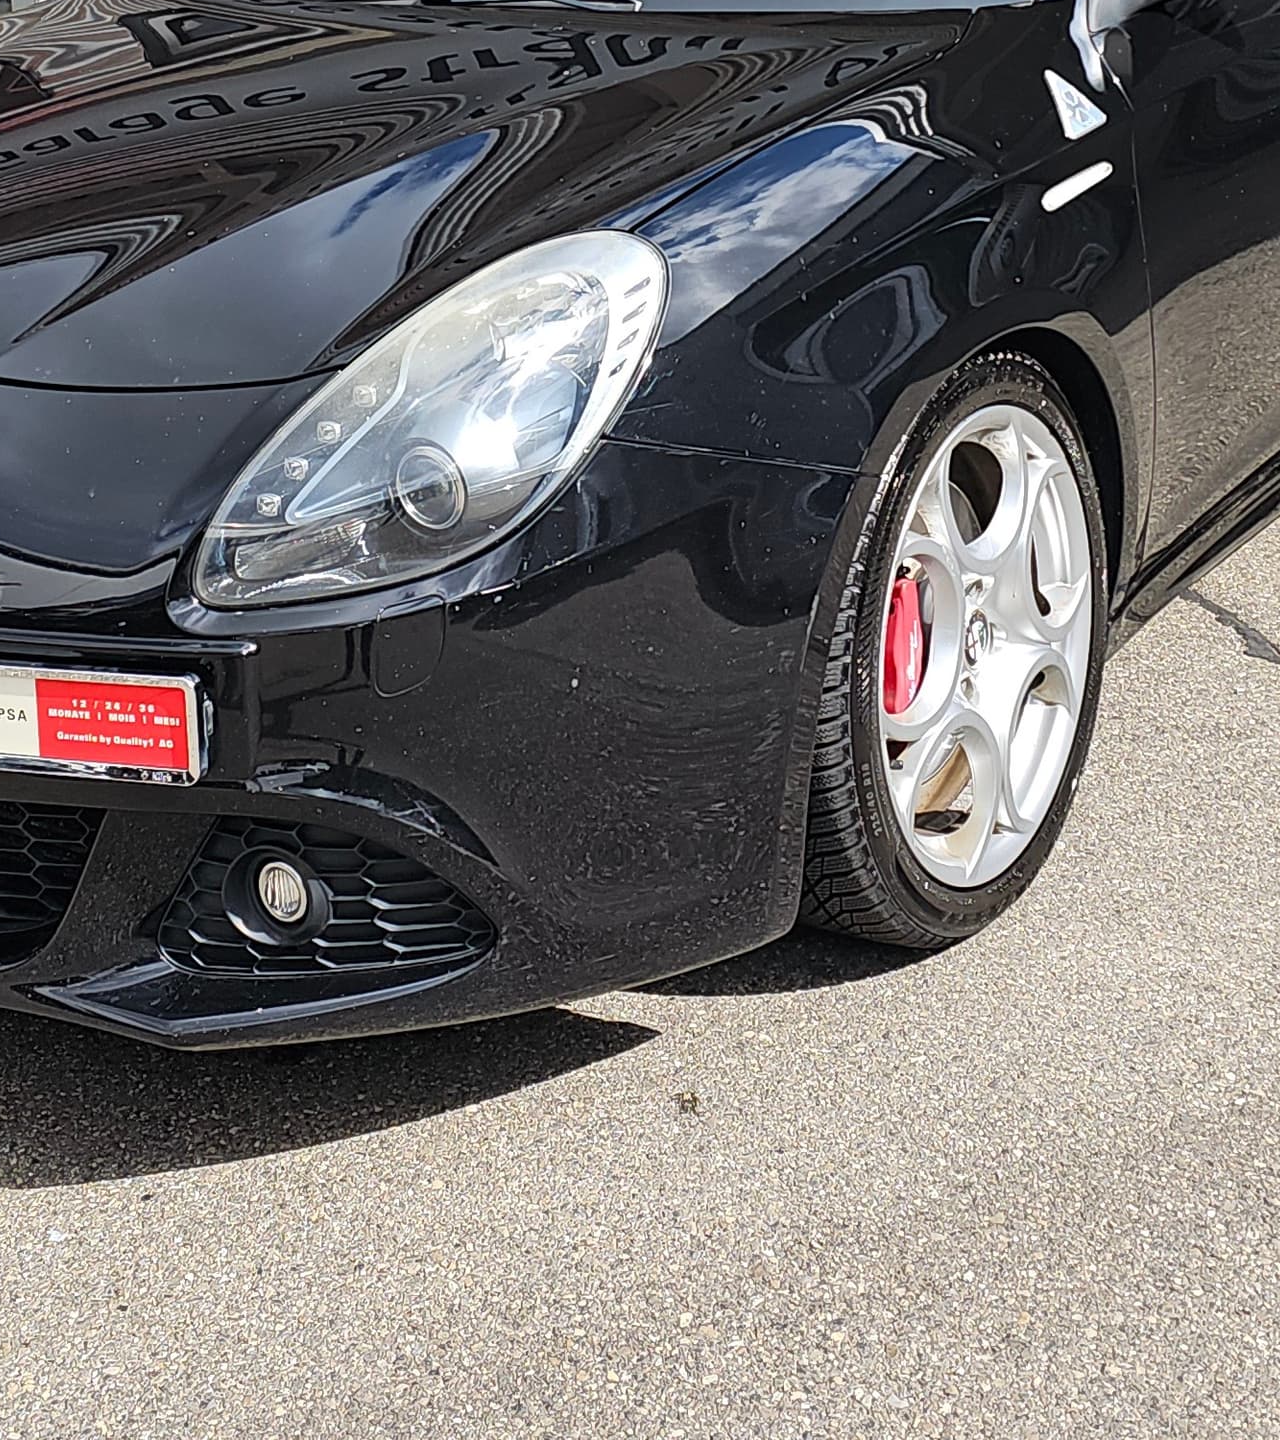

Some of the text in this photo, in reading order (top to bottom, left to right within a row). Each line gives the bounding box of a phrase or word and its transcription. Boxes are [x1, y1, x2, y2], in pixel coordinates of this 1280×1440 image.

[72, 699, 87, 708] 12
[48, 708, 91, 720] MONATE
[99, 734, 112, 746] by
